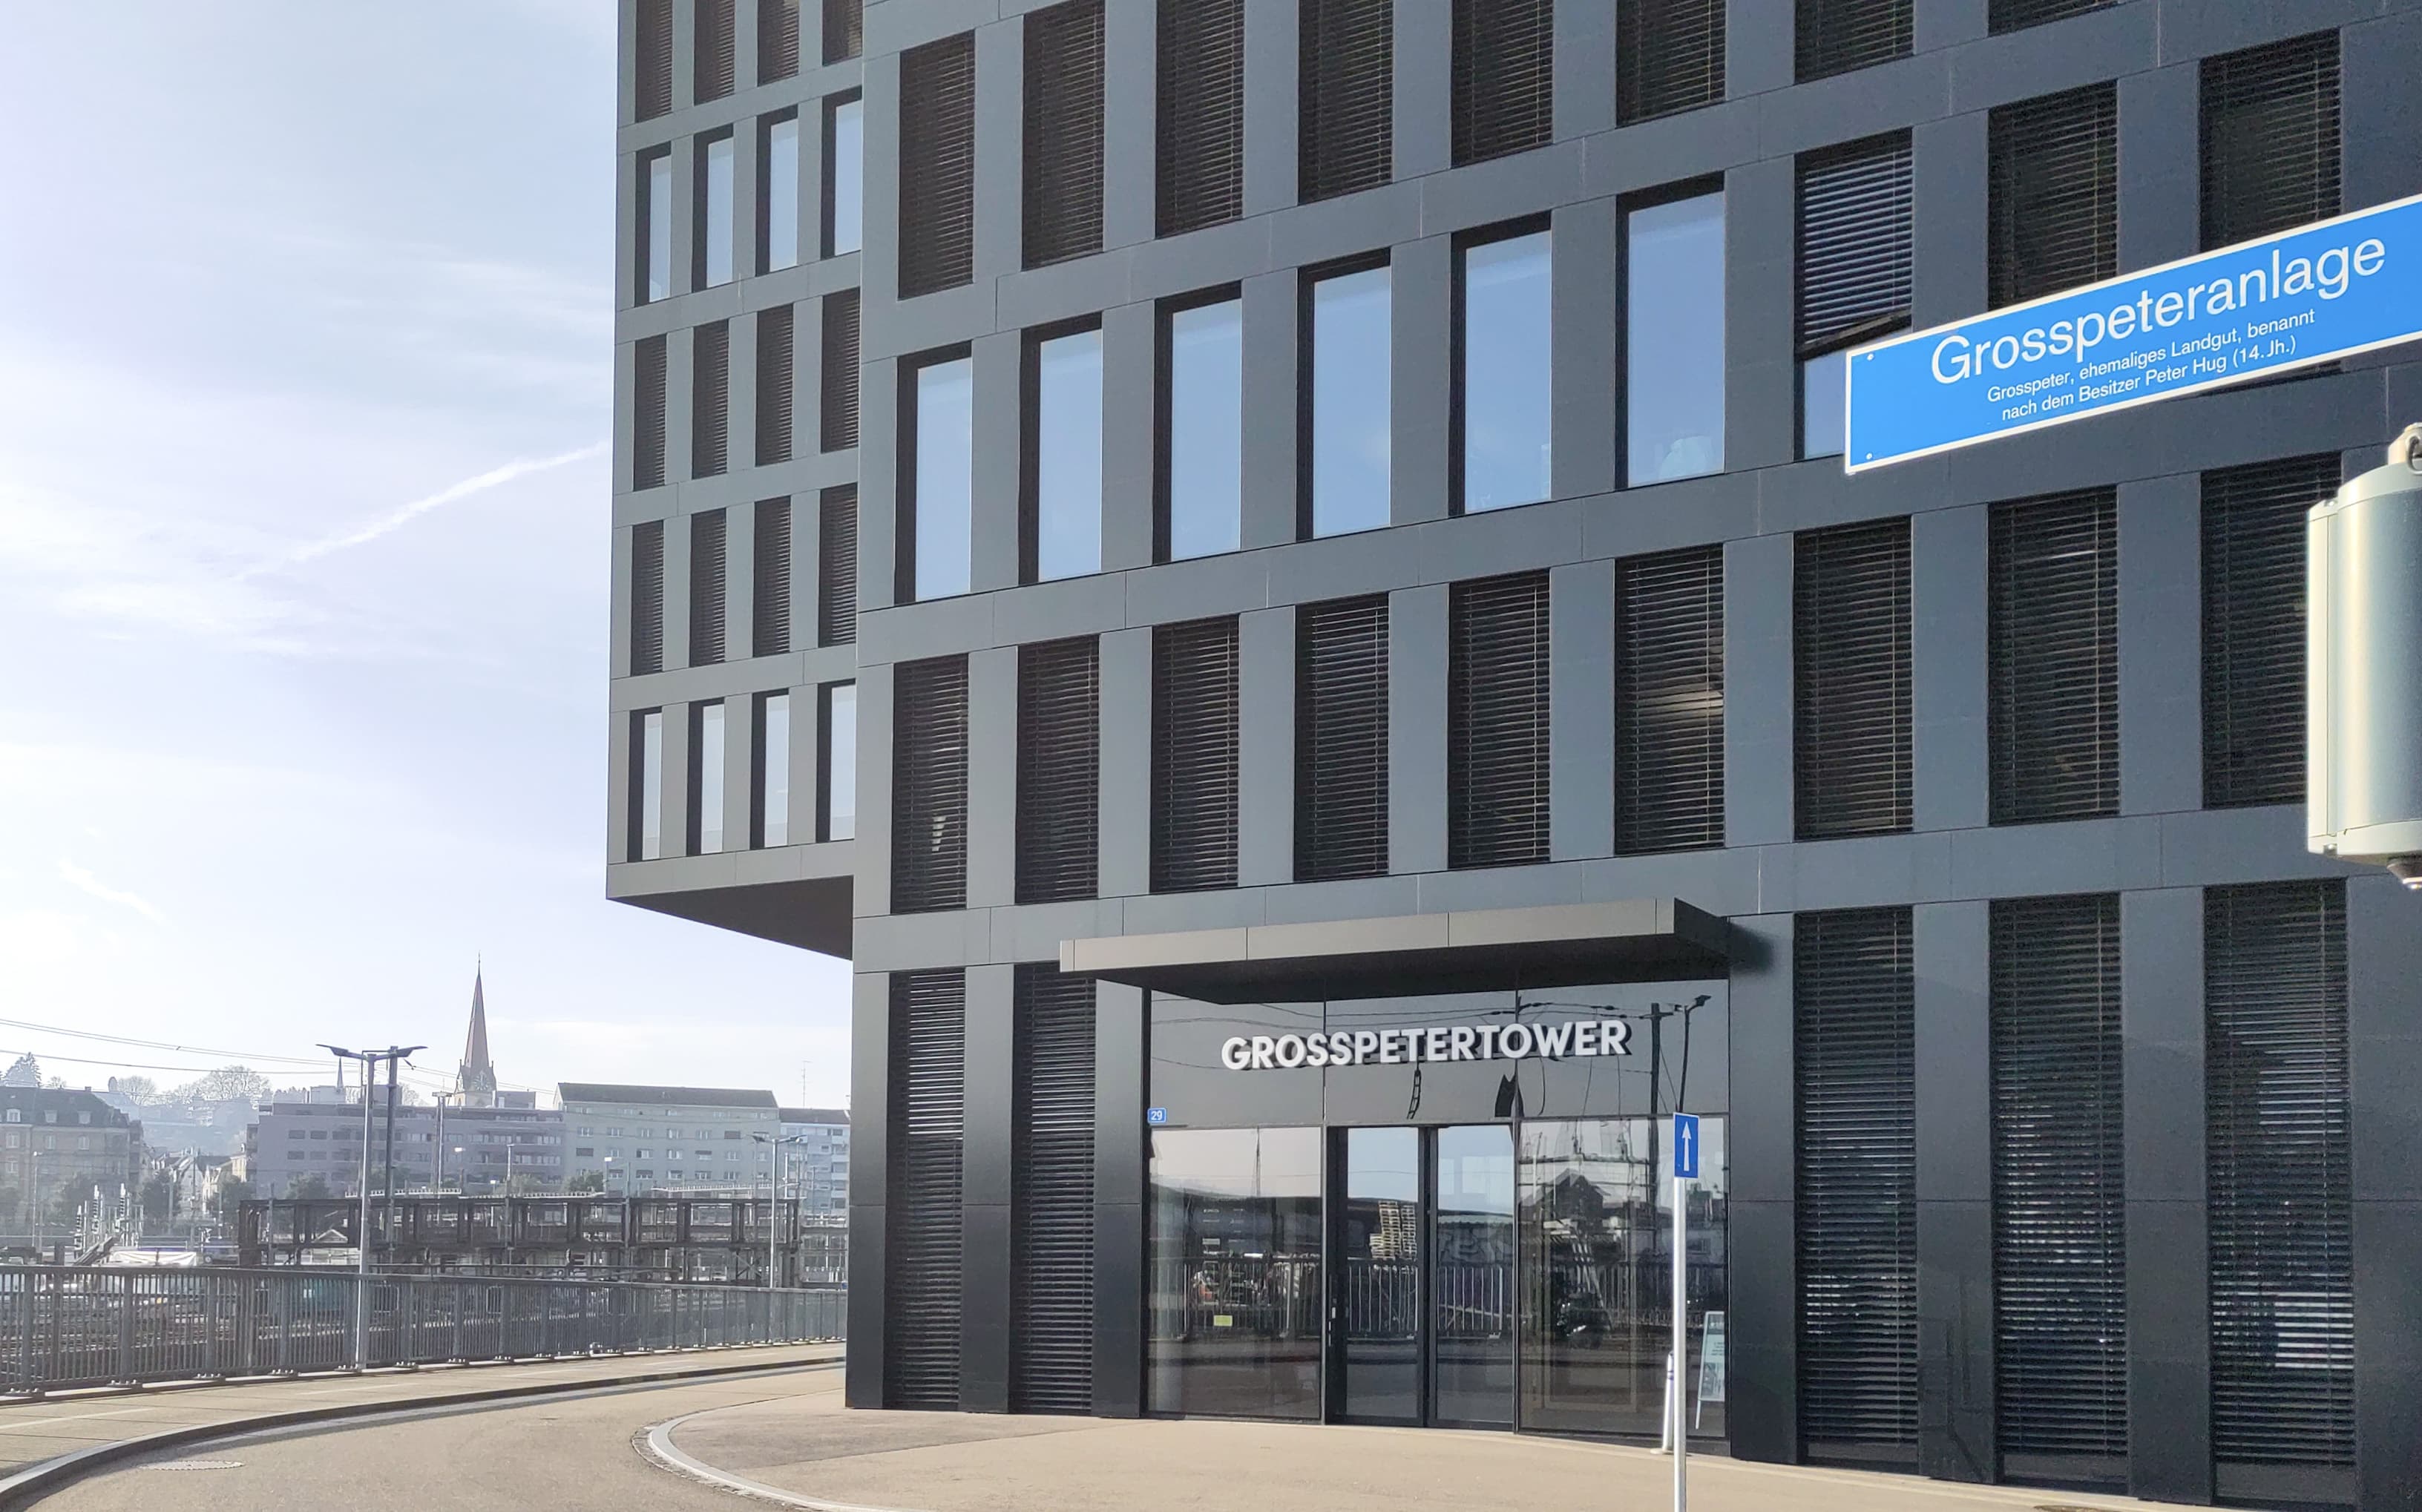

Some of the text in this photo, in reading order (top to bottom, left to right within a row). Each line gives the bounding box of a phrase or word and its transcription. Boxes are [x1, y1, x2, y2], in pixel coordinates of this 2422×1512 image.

[1931, 237, 2386, 384] Grosspeteranlage
[1987, 308, 2315, 402] Grosspeter, ehemaliges Landgut, benannt
[2002, 400, 2037, 421] nach
[2041, 393, 2074, 411] dem
[2078, 377, 2141, 402] Besitzer
[2145, 364, 2188, 386] Peter
[2193, 355, 2227, 375] Hug
[1221, 1019, 1632, 1071] GROSSPETERTOWER
[1151, 1110, 1163, 1121] 29
